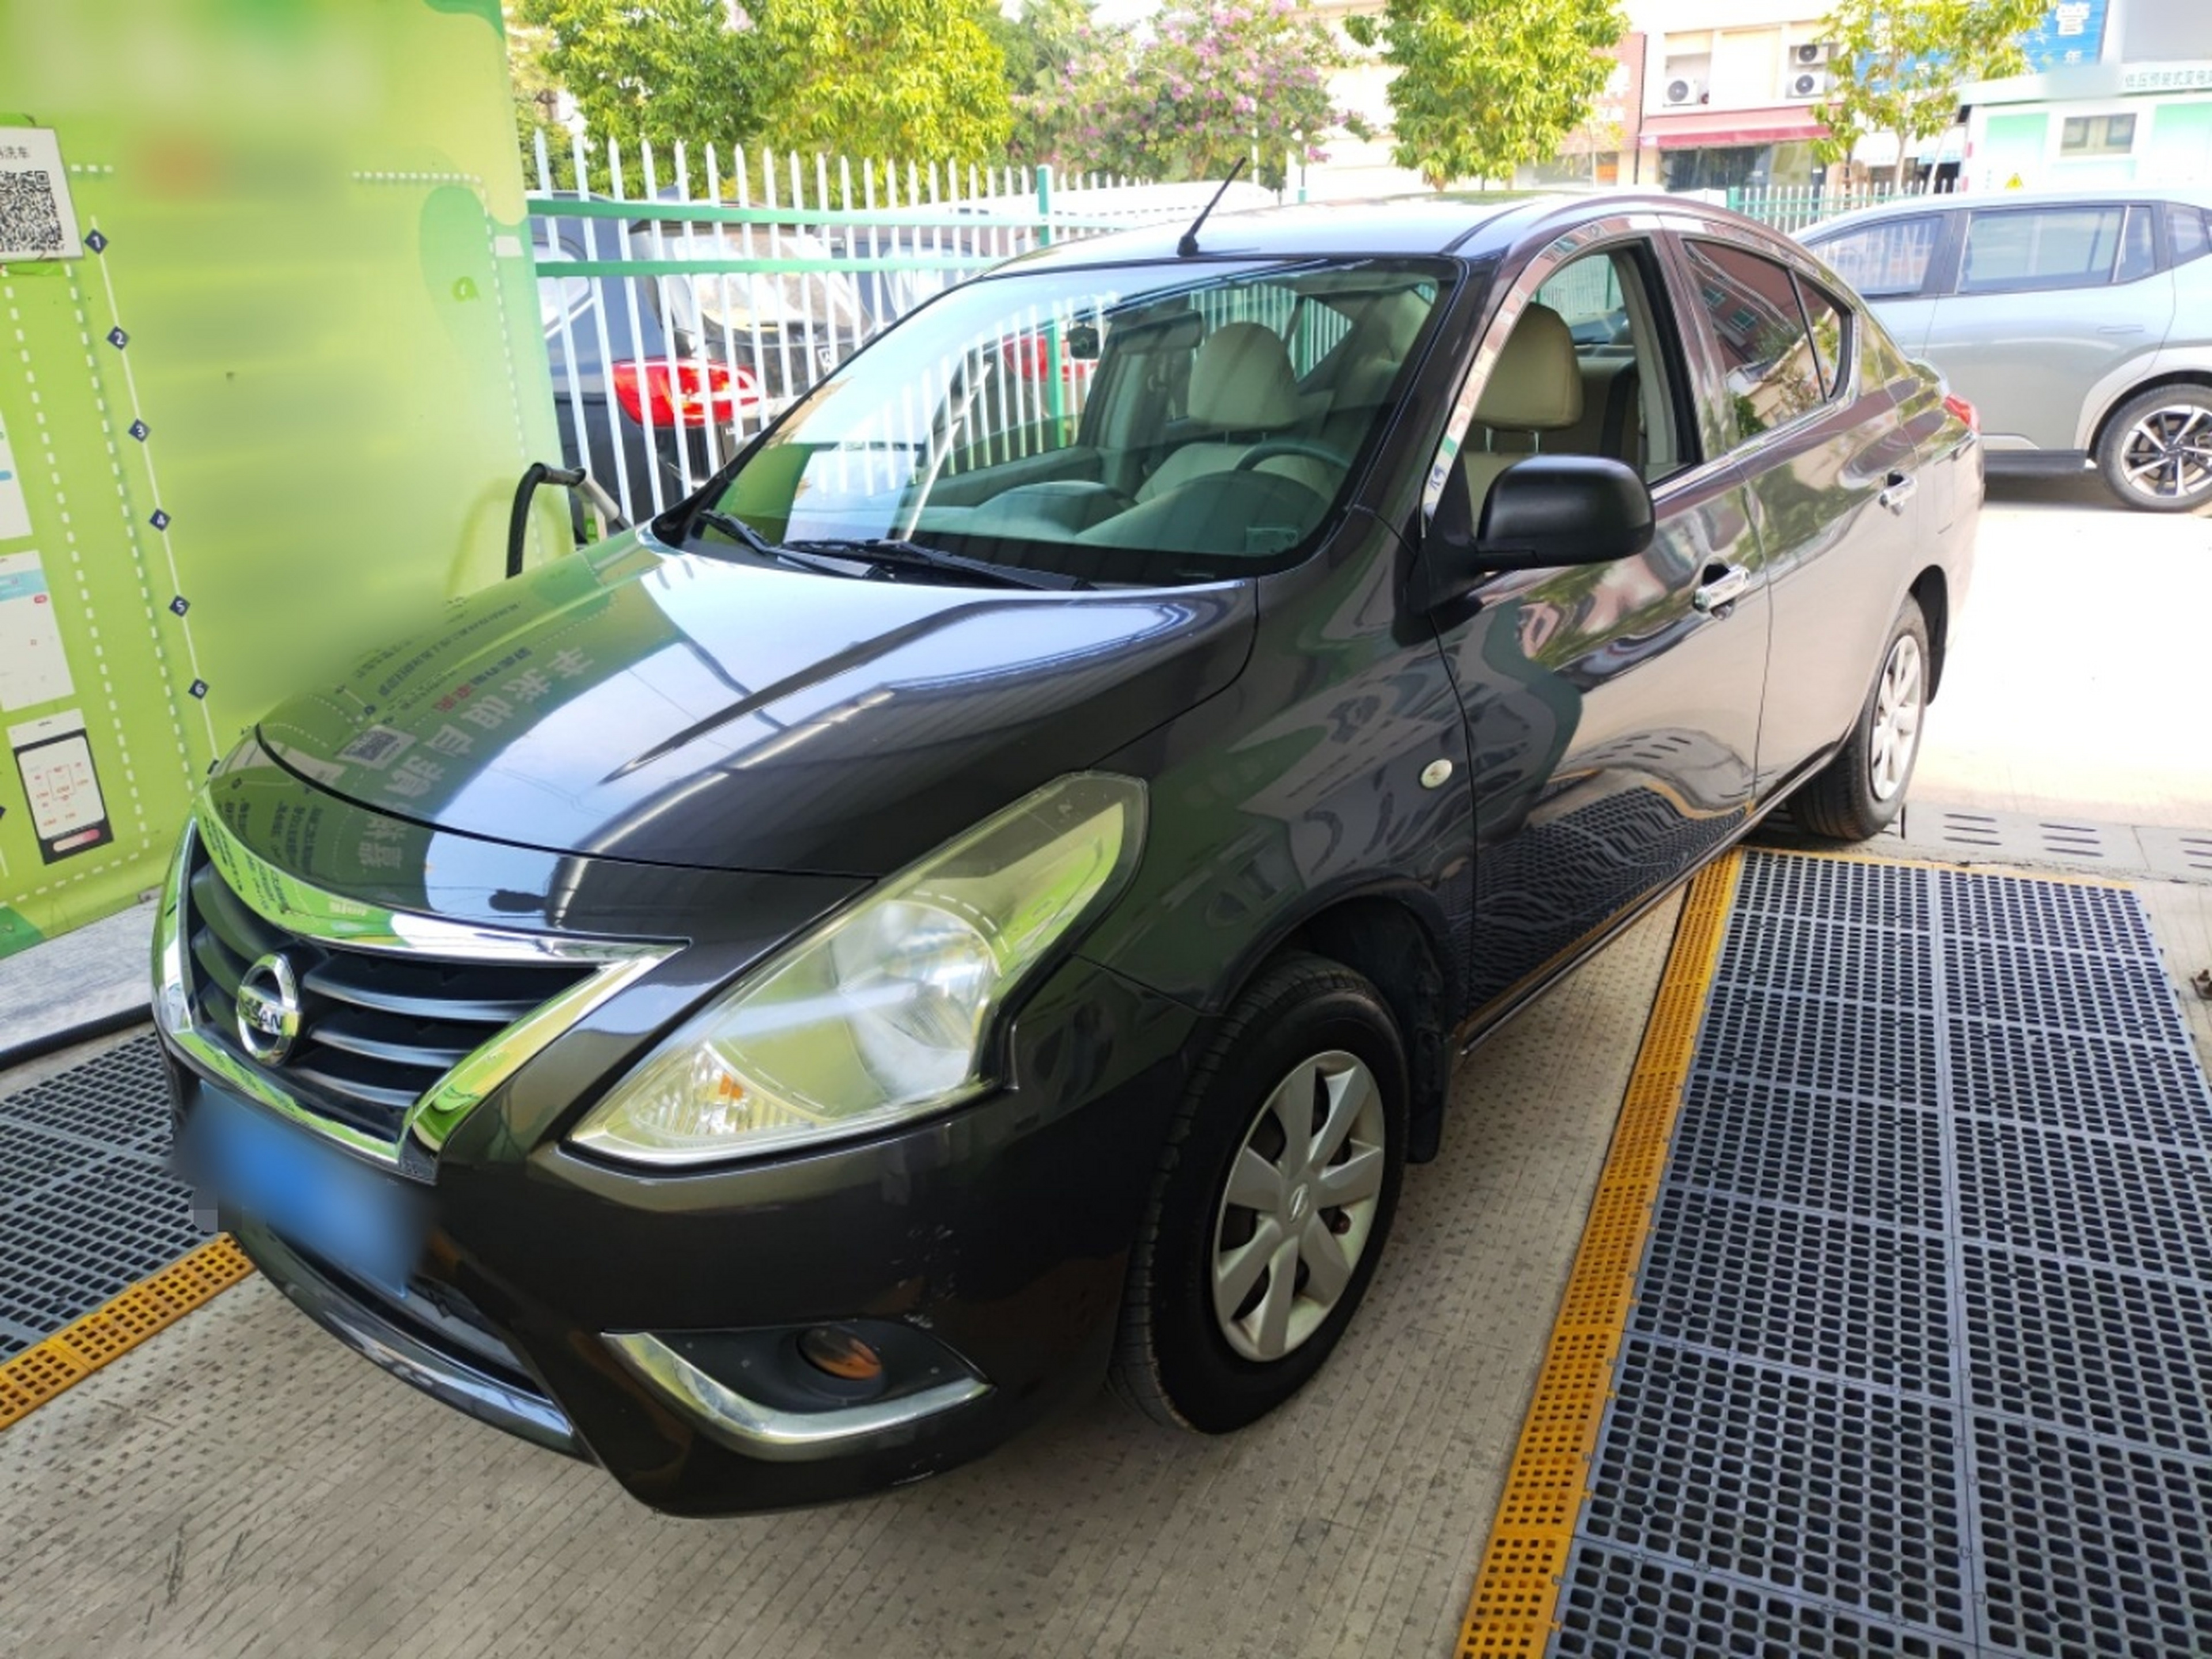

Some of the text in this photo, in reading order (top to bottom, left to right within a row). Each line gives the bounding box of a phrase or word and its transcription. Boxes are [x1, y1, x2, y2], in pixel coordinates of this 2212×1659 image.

[92, 235, 101, 248] 1
[115, 331, 124, 345] 2
[136, 424, 145, 438] 3
[157, 514, 166, 525] 4
[176, 600, 185, 613] 5
[195, 683, 204, 695] 6
